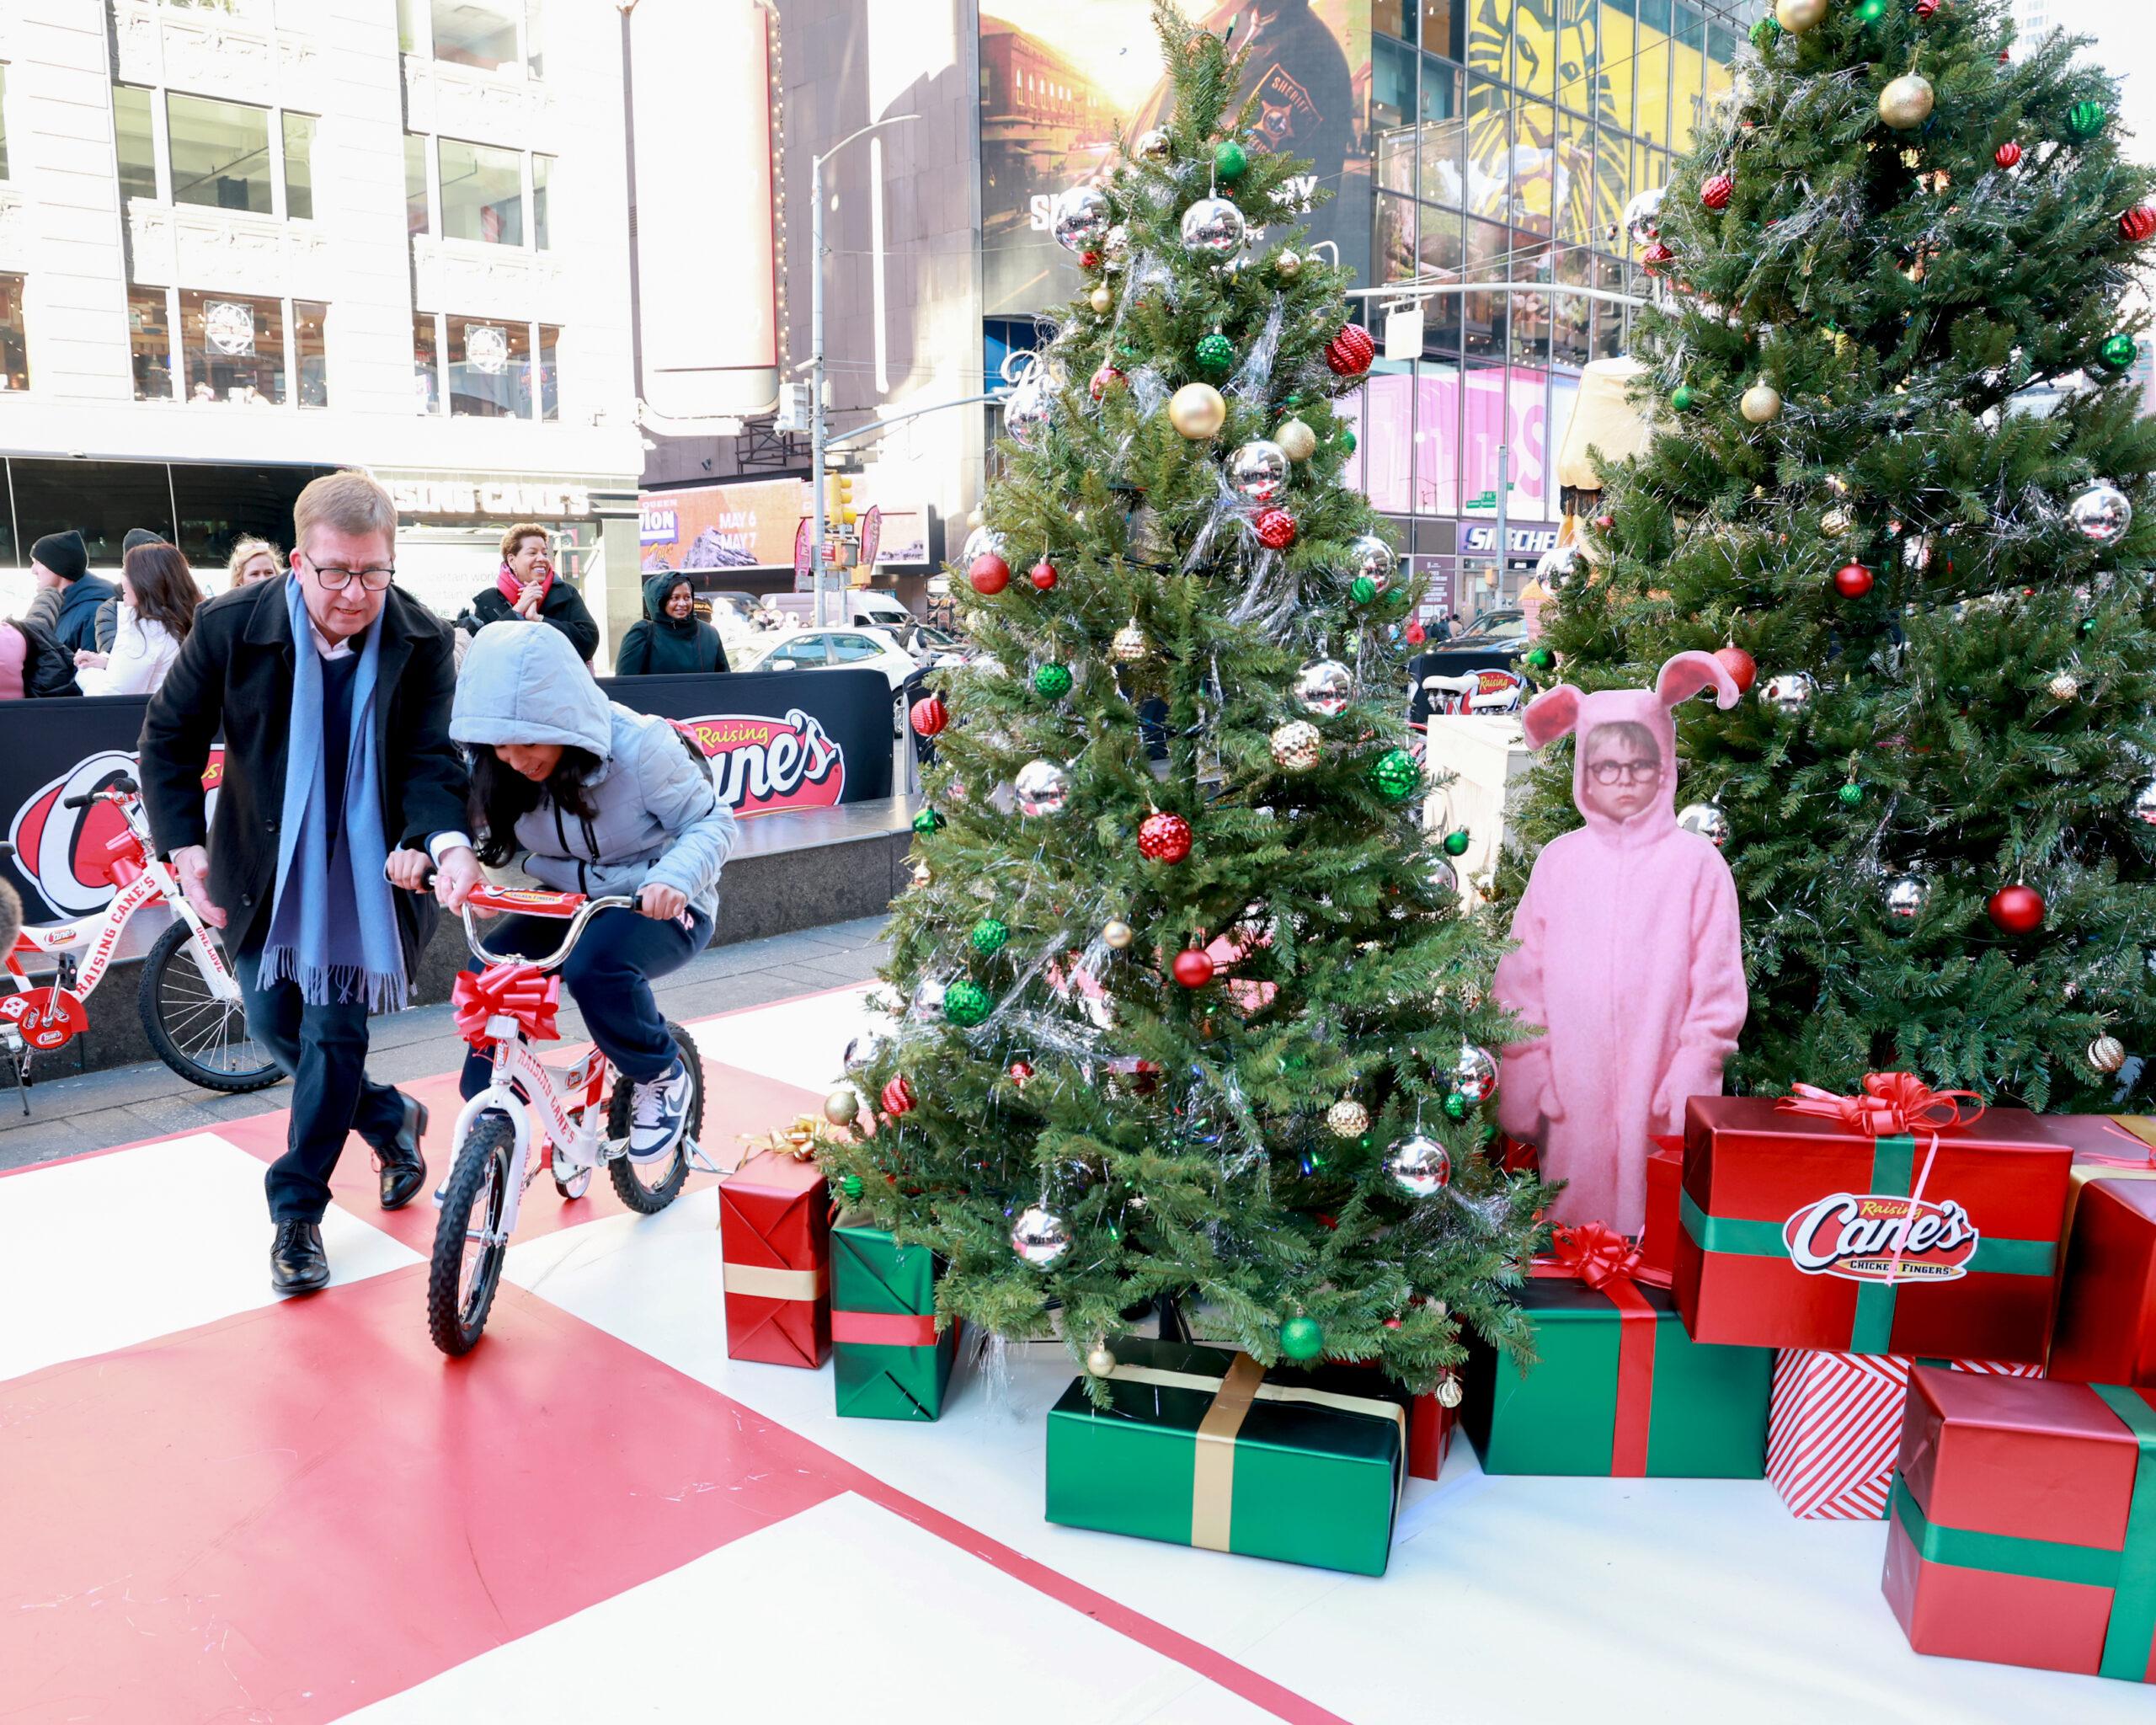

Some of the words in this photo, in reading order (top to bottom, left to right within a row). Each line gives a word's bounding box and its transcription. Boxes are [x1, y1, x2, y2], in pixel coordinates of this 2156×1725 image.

[719, 512, 745, 528] MAY
[748, 511, 756, 527] 6
[721, 533, 746, 550] MAY
[750, 532, 756, 548] 7
[1479, 676, 1509, 691] Raising
[696, 724, 769, 748] Raising
[111, 876, 156, 924] CANE'S
[76, 927, 116, 996] RAISING
[206, 948, 224, 973] LOVE
[517, 1049, 552, 1097] RAISING
[550, 1096, 575, 1144] CANE'S
[1792, 1194, 1974, 1268] Cane's
[1849, 1260, 1897, 1272] CHICKE
[1902, 1263, 1950, 1275] FINGERS
